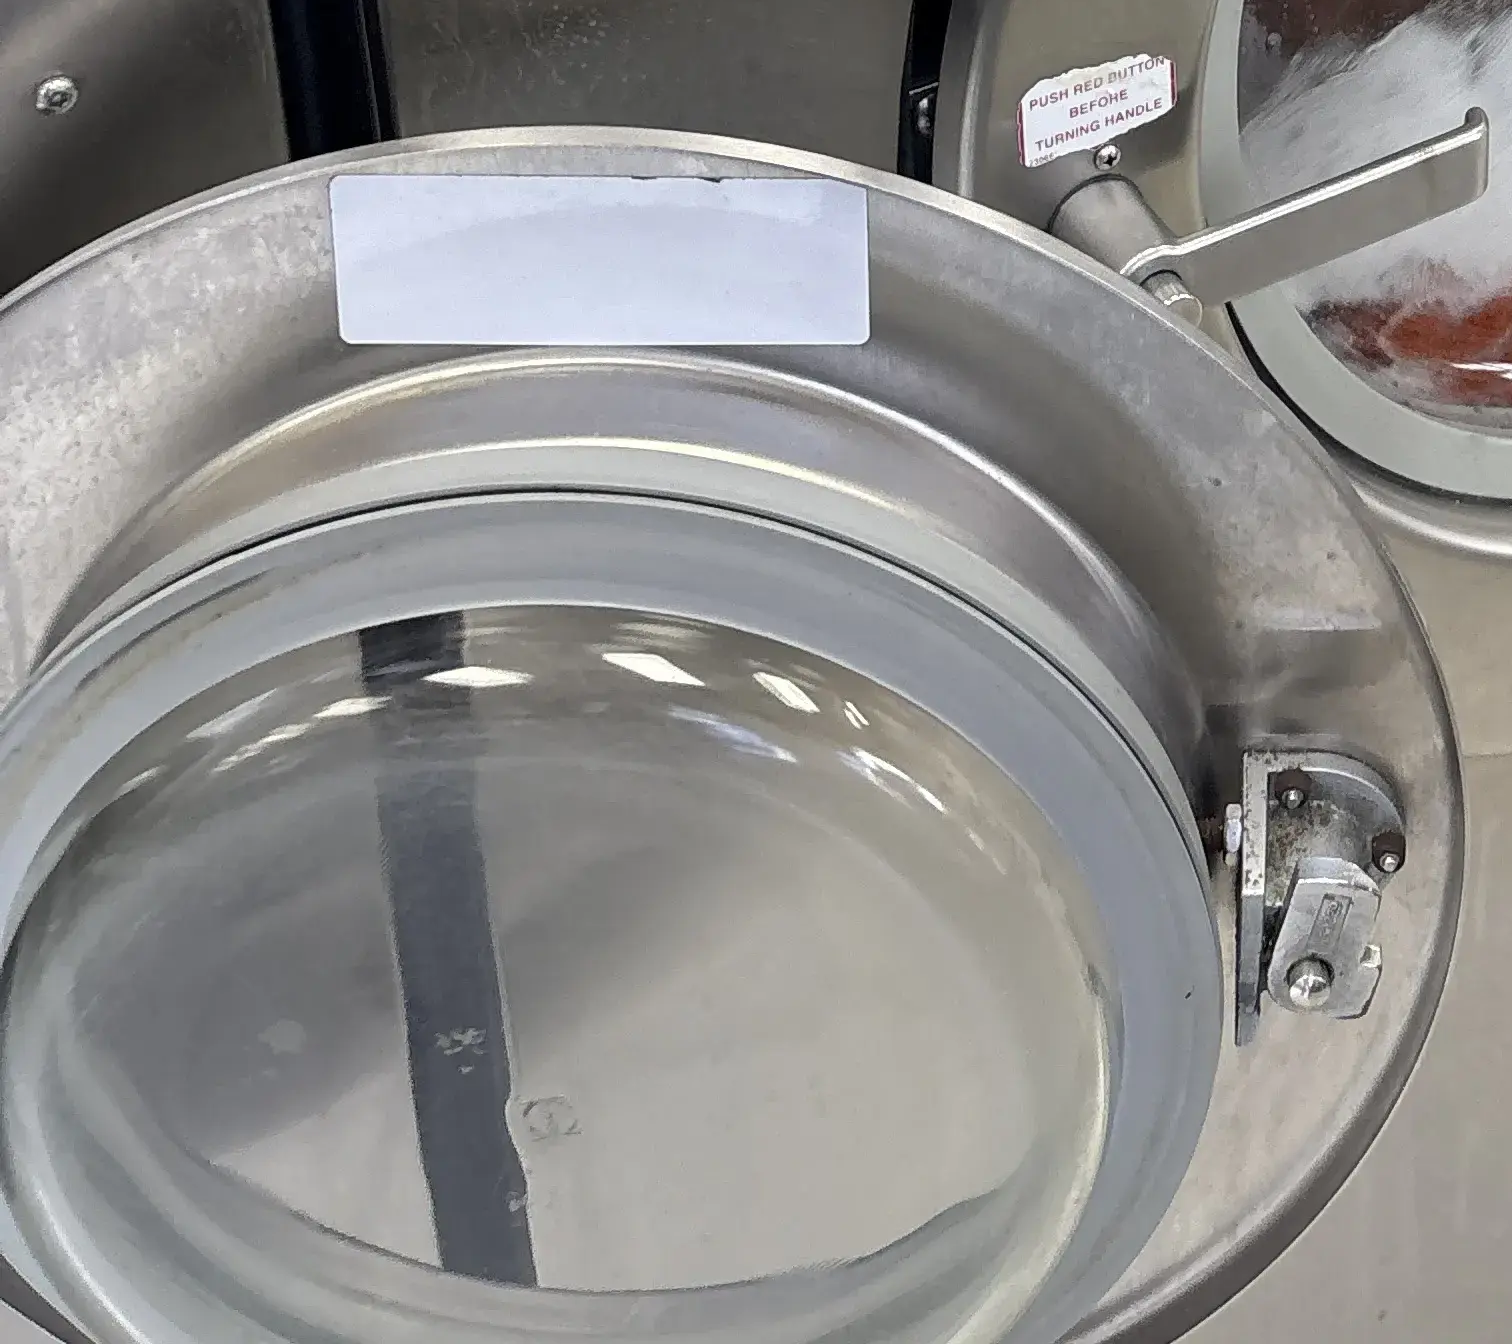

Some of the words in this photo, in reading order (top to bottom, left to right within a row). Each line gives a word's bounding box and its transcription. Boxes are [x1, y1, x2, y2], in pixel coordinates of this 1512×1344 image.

[1029, 88, 1069, 111] PUSH
[1073, 76, 1104, 96] RED
[1107, 57, 1165, 85] BUTTON
[1069, 88, 1129, 119] BEFORE
[1035, 119, 1101, 152] TURNING
[1105, 97, 1163, 127] HANDLE
